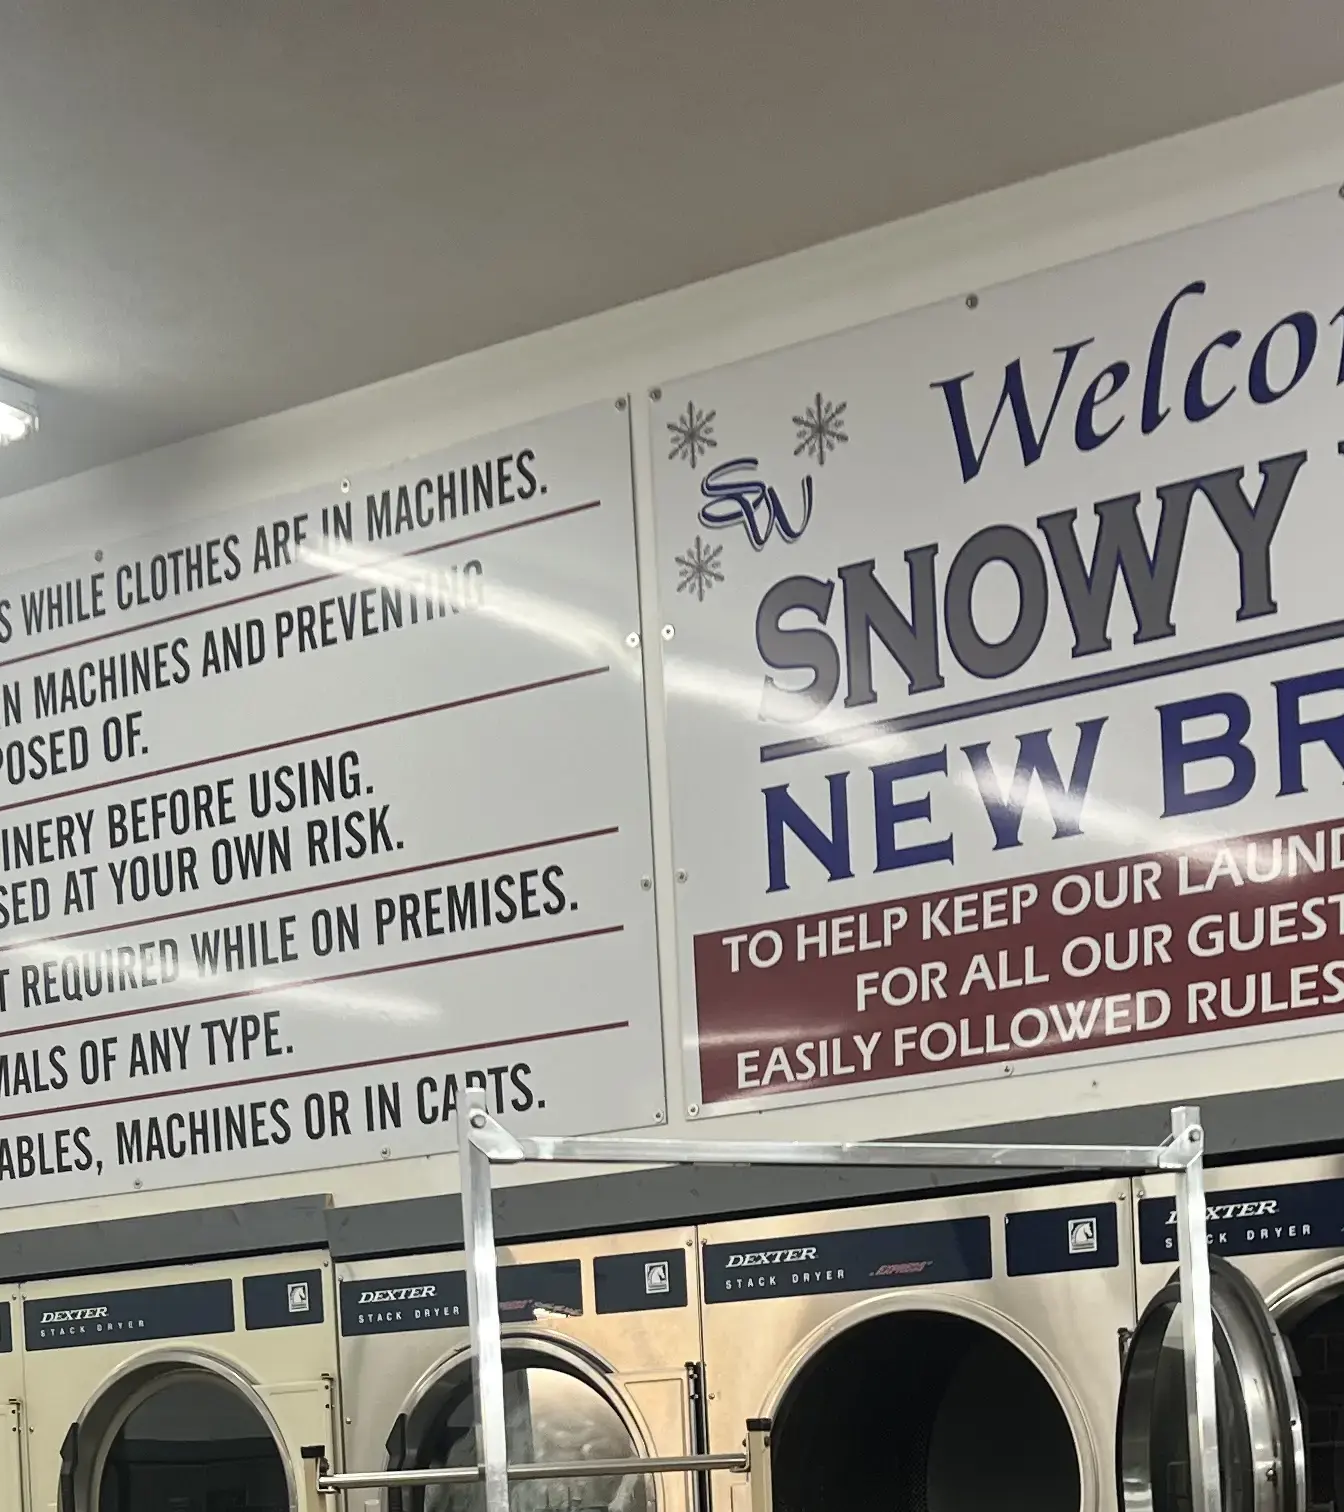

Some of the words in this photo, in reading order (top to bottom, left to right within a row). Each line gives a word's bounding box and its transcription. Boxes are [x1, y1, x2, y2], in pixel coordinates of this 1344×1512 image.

[21, 572, 106, 636] WHILE
[117, 534, 241, 611] CLOTHES
[254, 513, 308, 574] ARE
[322, 501, 352, 546] IN
[367, 449, 547, 542] MACHINES.
[755, 450, 1308, 723] SNOWY
[34, 637, 190, 719] MACHINES
[202, 619, 265, 677] AND
[103, 710, 148, 762] OF.
[108, 777, 236, 849] BEFORE
[250, 750, 373, 818] USING.
[761, 716, 1109, 895] NEW
[64, 865, 98, 916] AT
[109, 846, 199, 905] YOUR
[212, 825, 291, 885] OWN
[307, 804, 404, 867] RISK.
[22, 939, 178, 1008] REQUIRED
[191, 915, 298, 974] WHILE
[312, 903, 359, 956] ON
[375, 865, 578, 946] PREMISES.
[722, 926, 784, 974] TO
[795, 907, 909, 965] HELP
[922, 884, 1042, 940] KEEP
[1052, 859, 1163, 916] OUR
[857, 962, 948, 1012] FOR
[960, 946, 1050, 996] ALL
[1062, 924, 1173, 978] OUR
[80, 1036, 117, 1085] OF
[129, 1024, 190, 1078] ANY
[201, 1010, 293, 1065] TYPE.
[735, 1030, 882, 1092] EASILY
[893, 989, 1172, 1066] FOLLOWED
[116, 1098, 291, 1165] MACHINES
[304, 1090, 350, 1140] OR
[365, 1082, 401, 1132] IN
[725, 1247, 817, 1269] DEXTER
[1247, 1224, 1312, 1241] DRYER
[40, 1306, 109, 1325] DEXTER
[358, 1285, 436, 1304] DEXTER
[358, 1311, 403, 1324] STACK
[414, 1306, 461, 1319] DRYER
[725, 1276, 778, 1291] STACK
[792, 1269, 846, 1284] DRYER
[40, 1325, 85, 1339] STACK
[97, 1319, 146, 1334] DRYER
